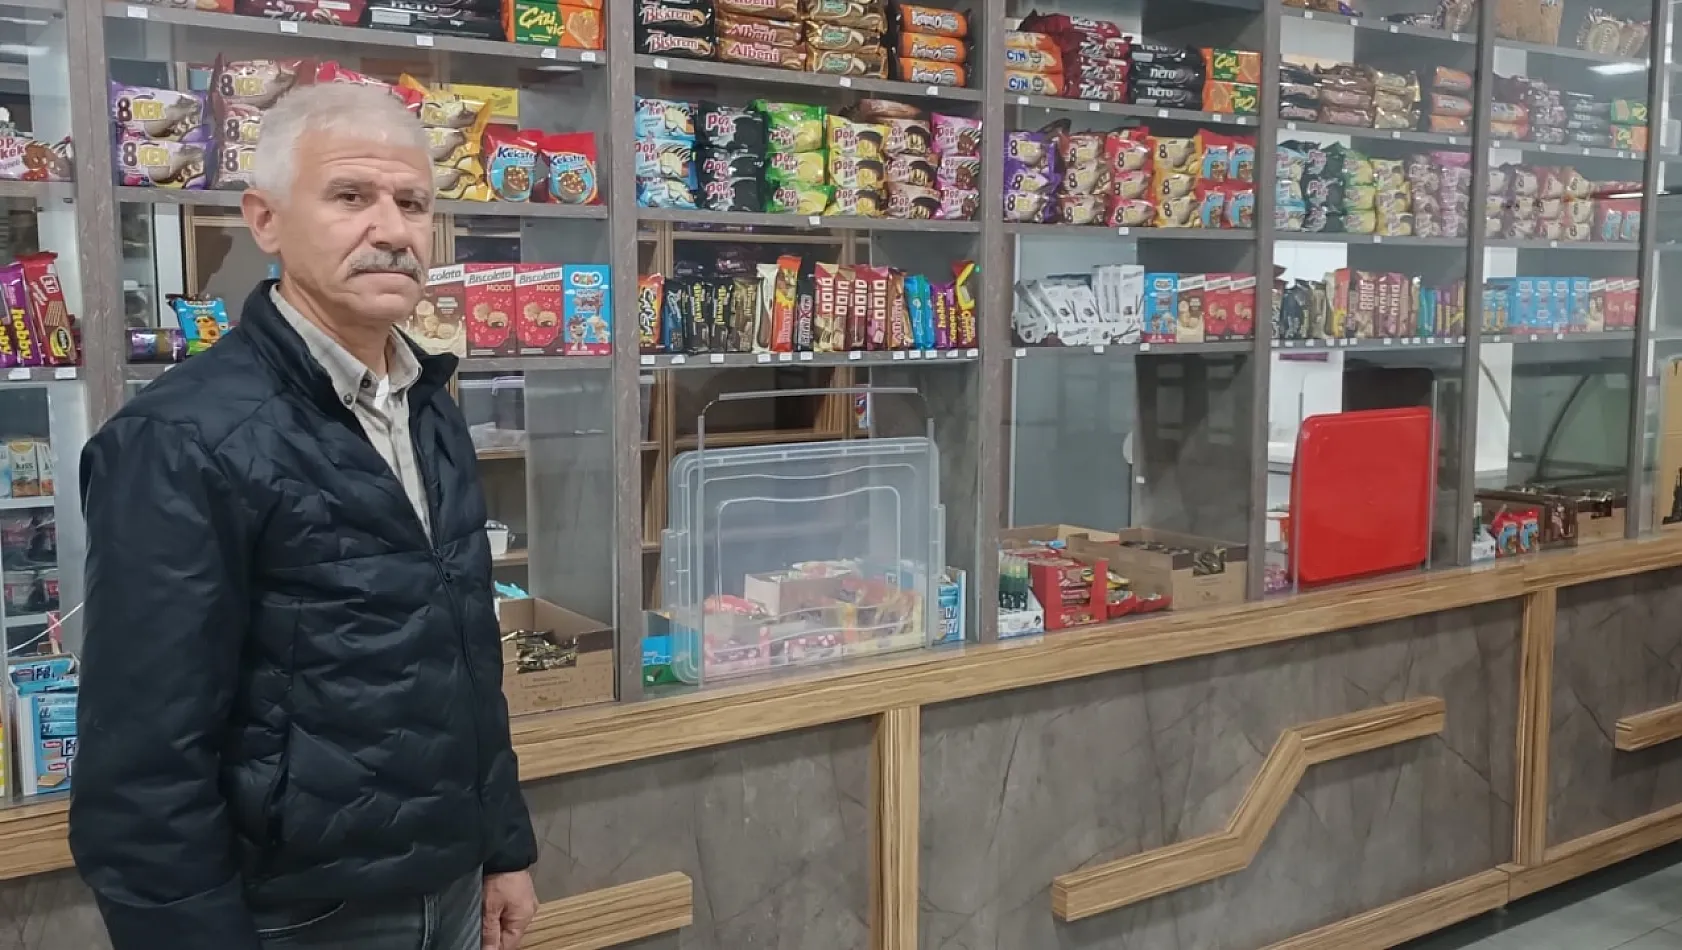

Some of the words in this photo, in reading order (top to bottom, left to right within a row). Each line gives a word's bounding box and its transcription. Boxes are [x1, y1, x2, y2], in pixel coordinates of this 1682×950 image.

[728, 42, 780, 62] Albeni
[220, 74, 235, 96] 8
[117, 98, 132, 122] 8
[226, 118, 239, 142] 8
[123, 142, 138, 167] 8
[224, 149, 238, 172] 8
[10, 308, 33, 359] hobby
